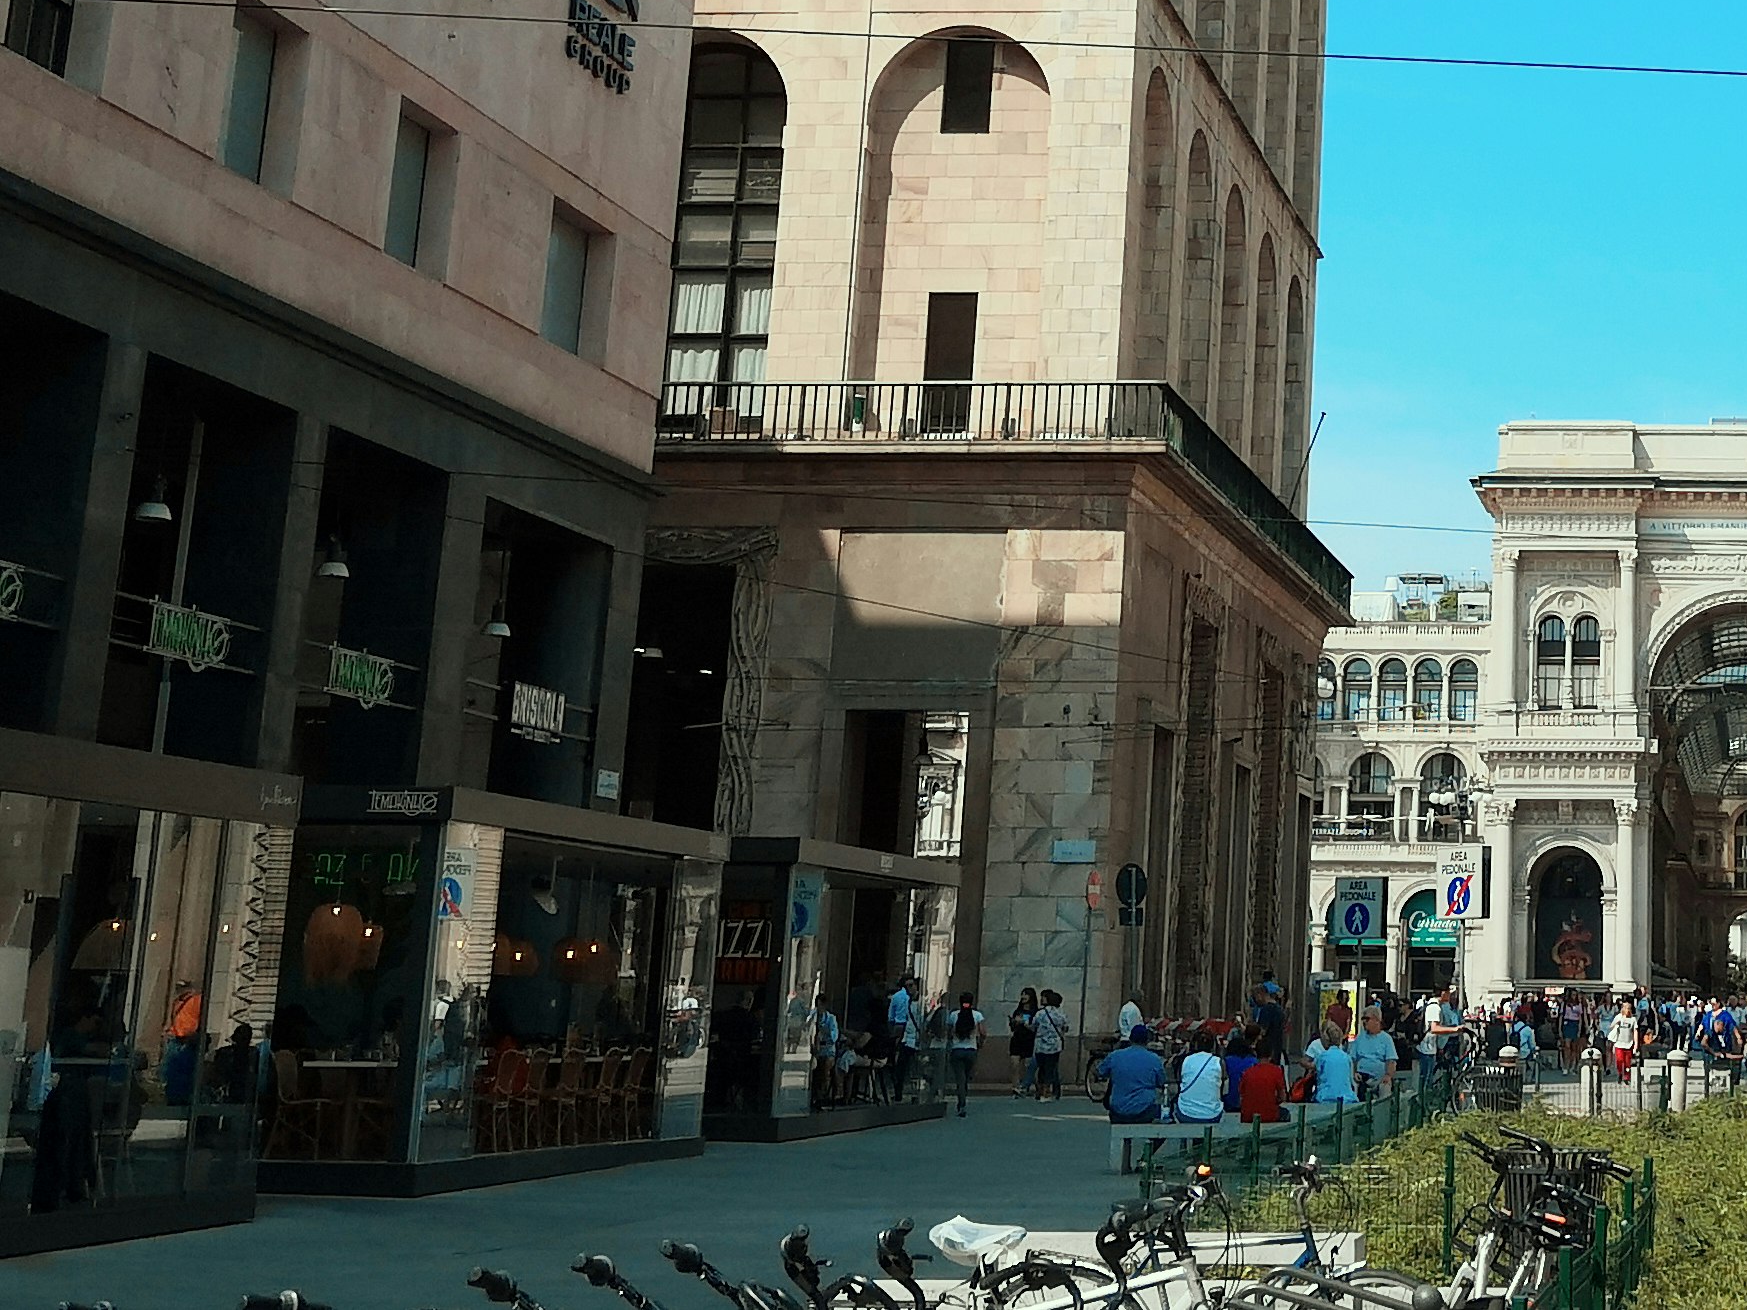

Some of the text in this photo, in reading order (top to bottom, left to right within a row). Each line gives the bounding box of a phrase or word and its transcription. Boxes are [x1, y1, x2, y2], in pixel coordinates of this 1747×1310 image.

[565, 35, 631, 95] GROUP
[511, 681, 566, 734] BRISCOLA
[1450, 852, 1468, 861] AREA
[1441, 862, 1476, 875] PEDONALE
[1349, 881, 1368, 890] AREA
[1340, 891, 1376, 902] PEDONALE
